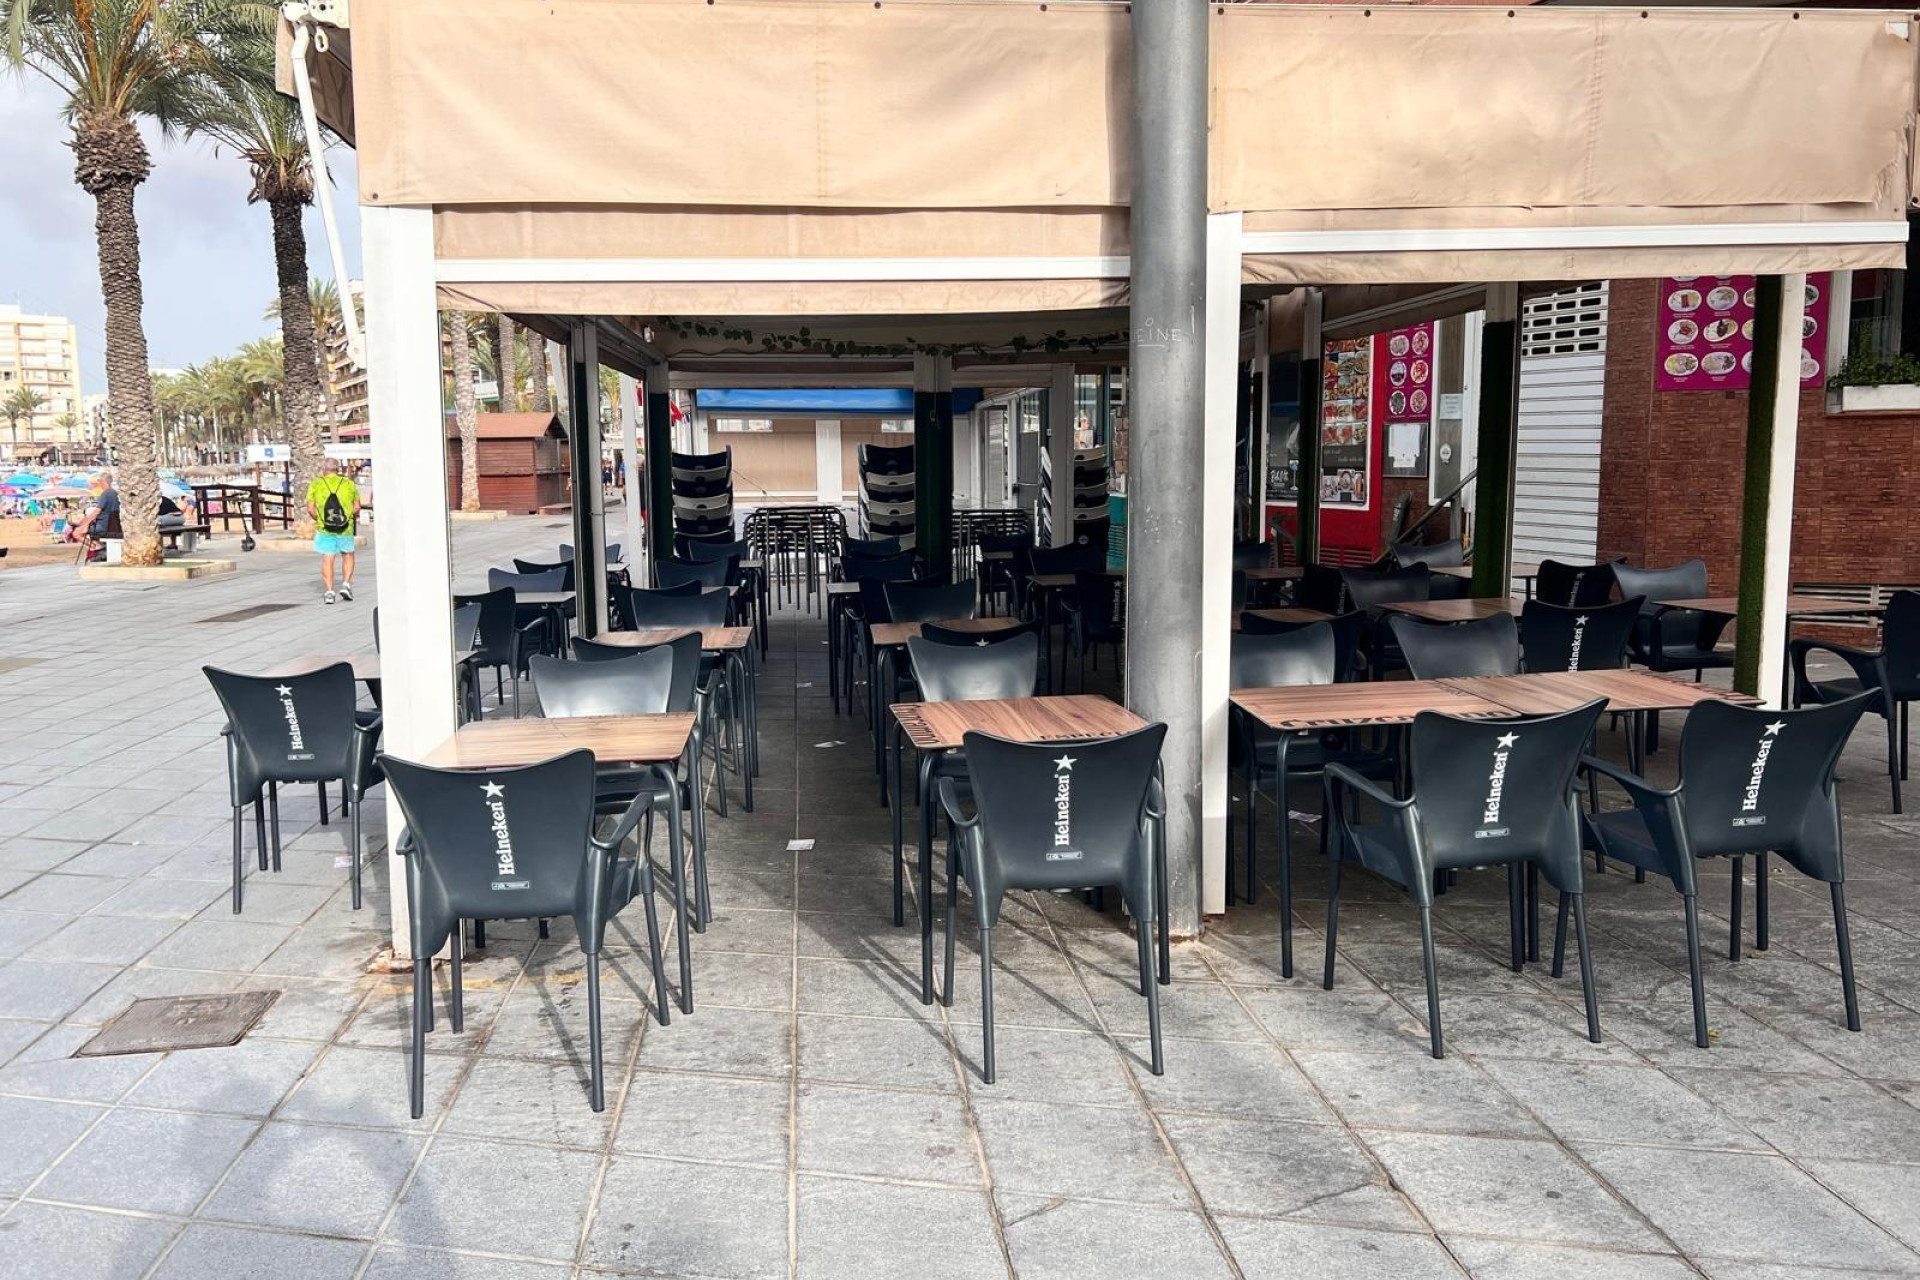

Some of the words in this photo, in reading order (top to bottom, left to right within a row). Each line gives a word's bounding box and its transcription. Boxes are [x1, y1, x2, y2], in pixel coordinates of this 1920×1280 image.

[1567, 628, 1584, 672] Heineken
[280, 698, 304, 750] Heineken
[1054, 774, 1070, 846] Heineken
[1484, 752, 1509, 824] Heineken
[1742, 739, 1774, 811] Heineken
[486, 801, 516, 875] Heineken
